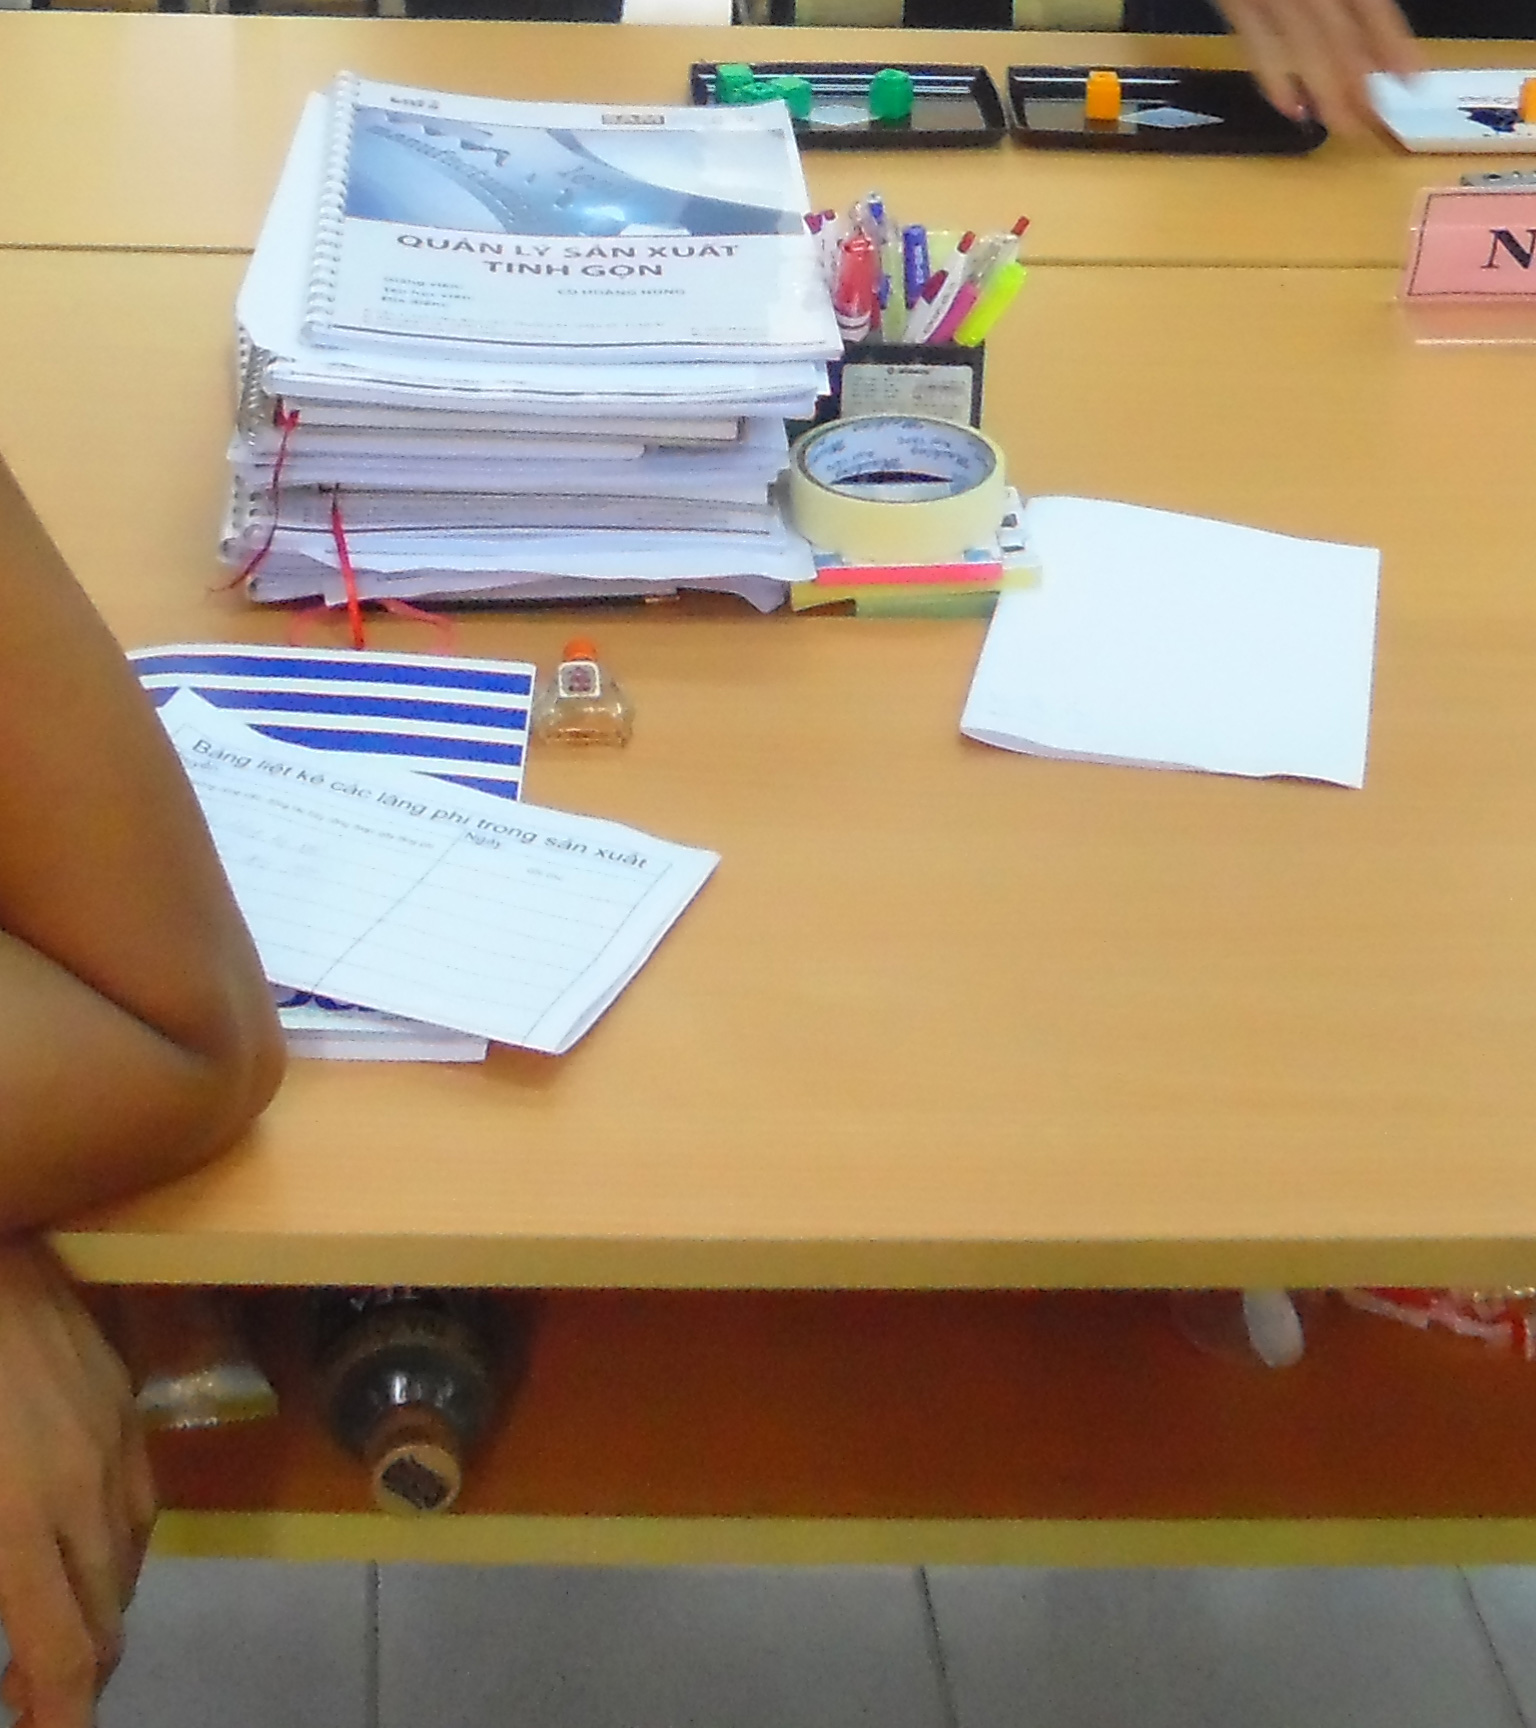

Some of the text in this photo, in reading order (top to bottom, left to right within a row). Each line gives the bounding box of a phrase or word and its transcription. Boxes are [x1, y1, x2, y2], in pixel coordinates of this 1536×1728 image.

[482, 260, 664, 279] TINH GỌN
[476, 818, 538, 845] trong
